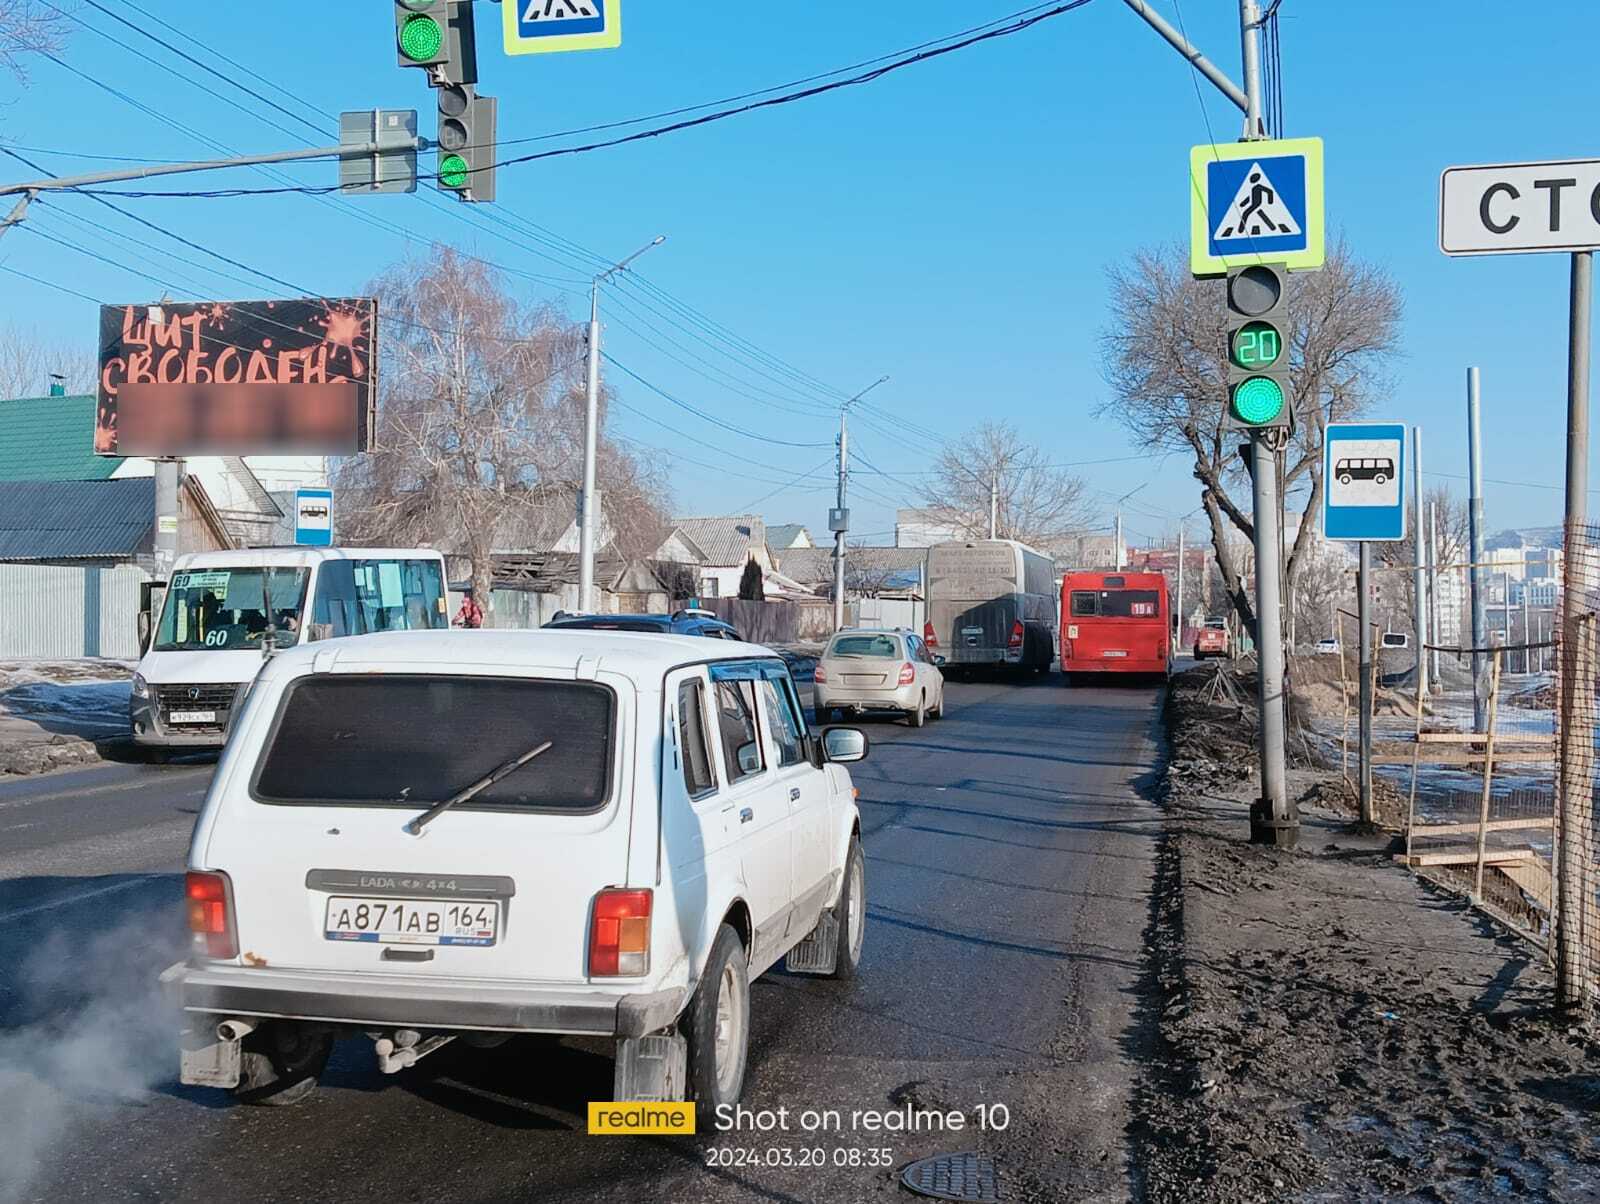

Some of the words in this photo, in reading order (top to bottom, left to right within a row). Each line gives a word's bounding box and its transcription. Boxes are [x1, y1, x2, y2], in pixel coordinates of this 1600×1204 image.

[1480, 178, 1600, 234] СТ
[122, 305, 207, 355] ЩИТ
[1240, 331, 1276, 362] 20
[174, 575, 190, 587] 60
[206, 630, 227, 646] 60
[360, 877, 395, 889] LADA
[337, 904, 440, 933] А871АВ
[449, 906, 487, 928] 164
